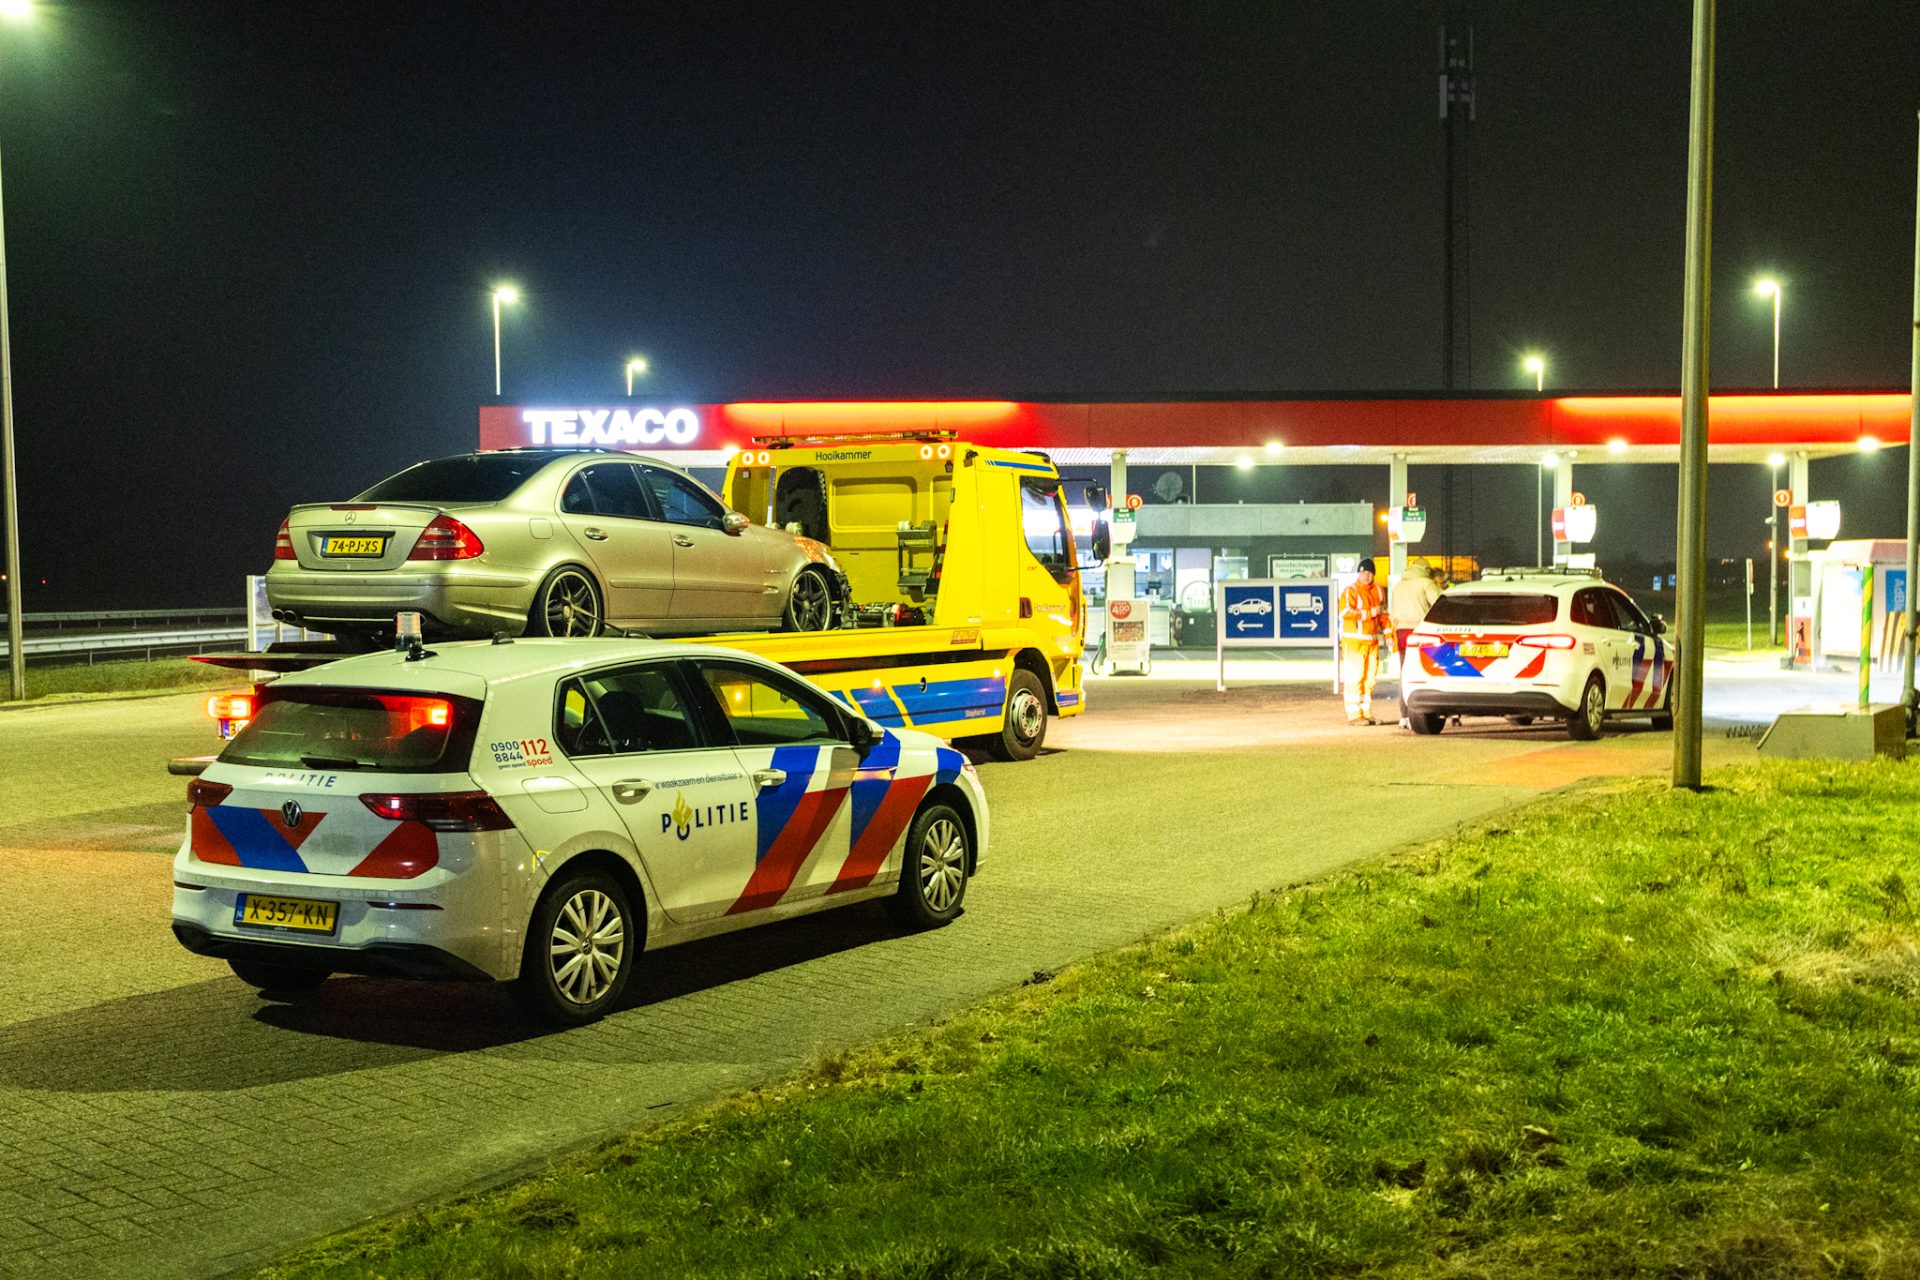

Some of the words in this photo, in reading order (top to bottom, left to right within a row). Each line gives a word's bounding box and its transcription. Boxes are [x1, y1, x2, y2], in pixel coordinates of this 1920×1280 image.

[522, 408, 699, 444] TEXACO
[815, 451, 872, 461] Hooikammer
[331, 540, 379, 552] 74-PJ-XS
[491, 741, 519, 752] 0900
[521, 739, 550, 755] 112
[495, 752, 523, 762] 8844
[526, 756, 553, 767] spoed
[661, 802, 748, 841] POLITIE
[250, 900, 328, 926] X-357-KN
